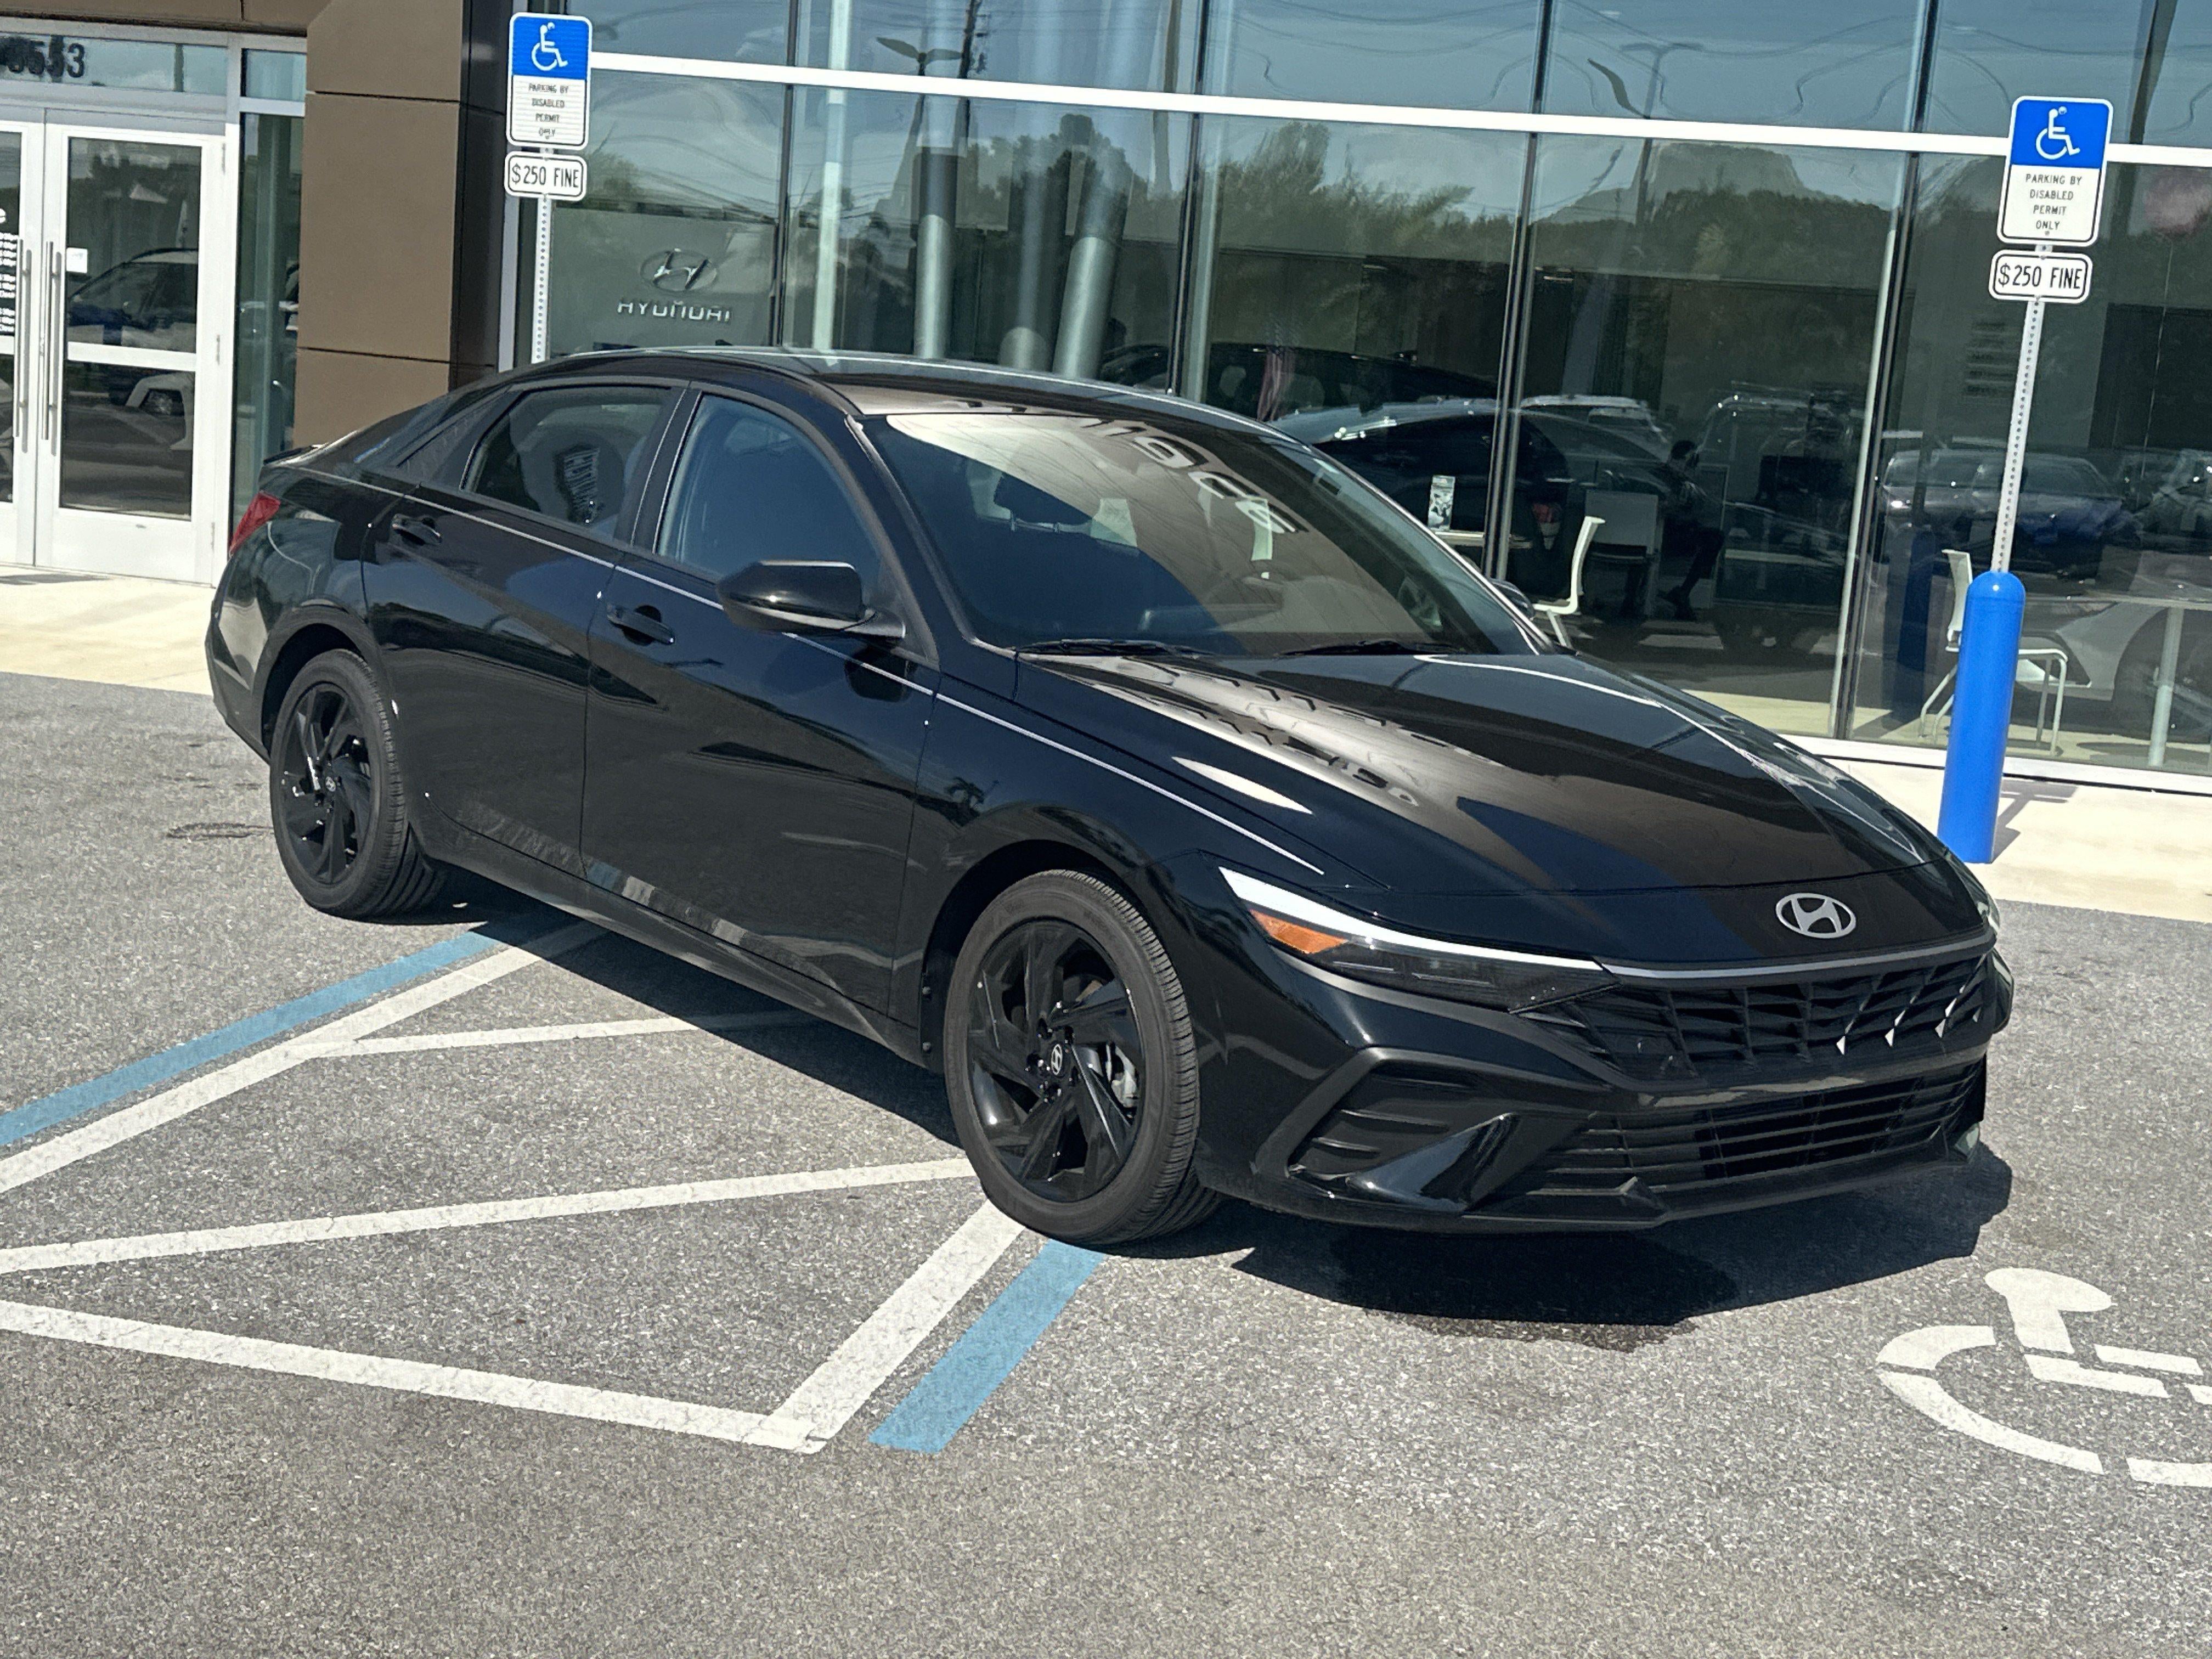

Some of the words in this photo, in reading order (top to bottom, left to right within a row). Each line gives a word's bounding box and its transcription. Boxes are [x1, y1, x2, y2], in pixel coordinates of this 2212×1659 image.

[528, 83, 557, 93] PARKING
[560, 85, 569, 93] BY
[532, 98, 565, 108] DISABLED
[535, 113, 560, 123] PERMIT
[512, 162, 546, 185] $250
[554, 167, 579, 188] FINE
[2025, 173, 2066, 184] PARKING
[2070, 176, 2082, 185] BY
[2030, 189, 2074, 200] DISABLED
[2033, 205, 2067, 216] PERMIT
[2036, 220, 2060, 230] ONLY
[1998, 263, 2042, 287] $250
[2050, 267, 2083, 289] FINE
[617, 300, 730, 322] HYUNDAI
